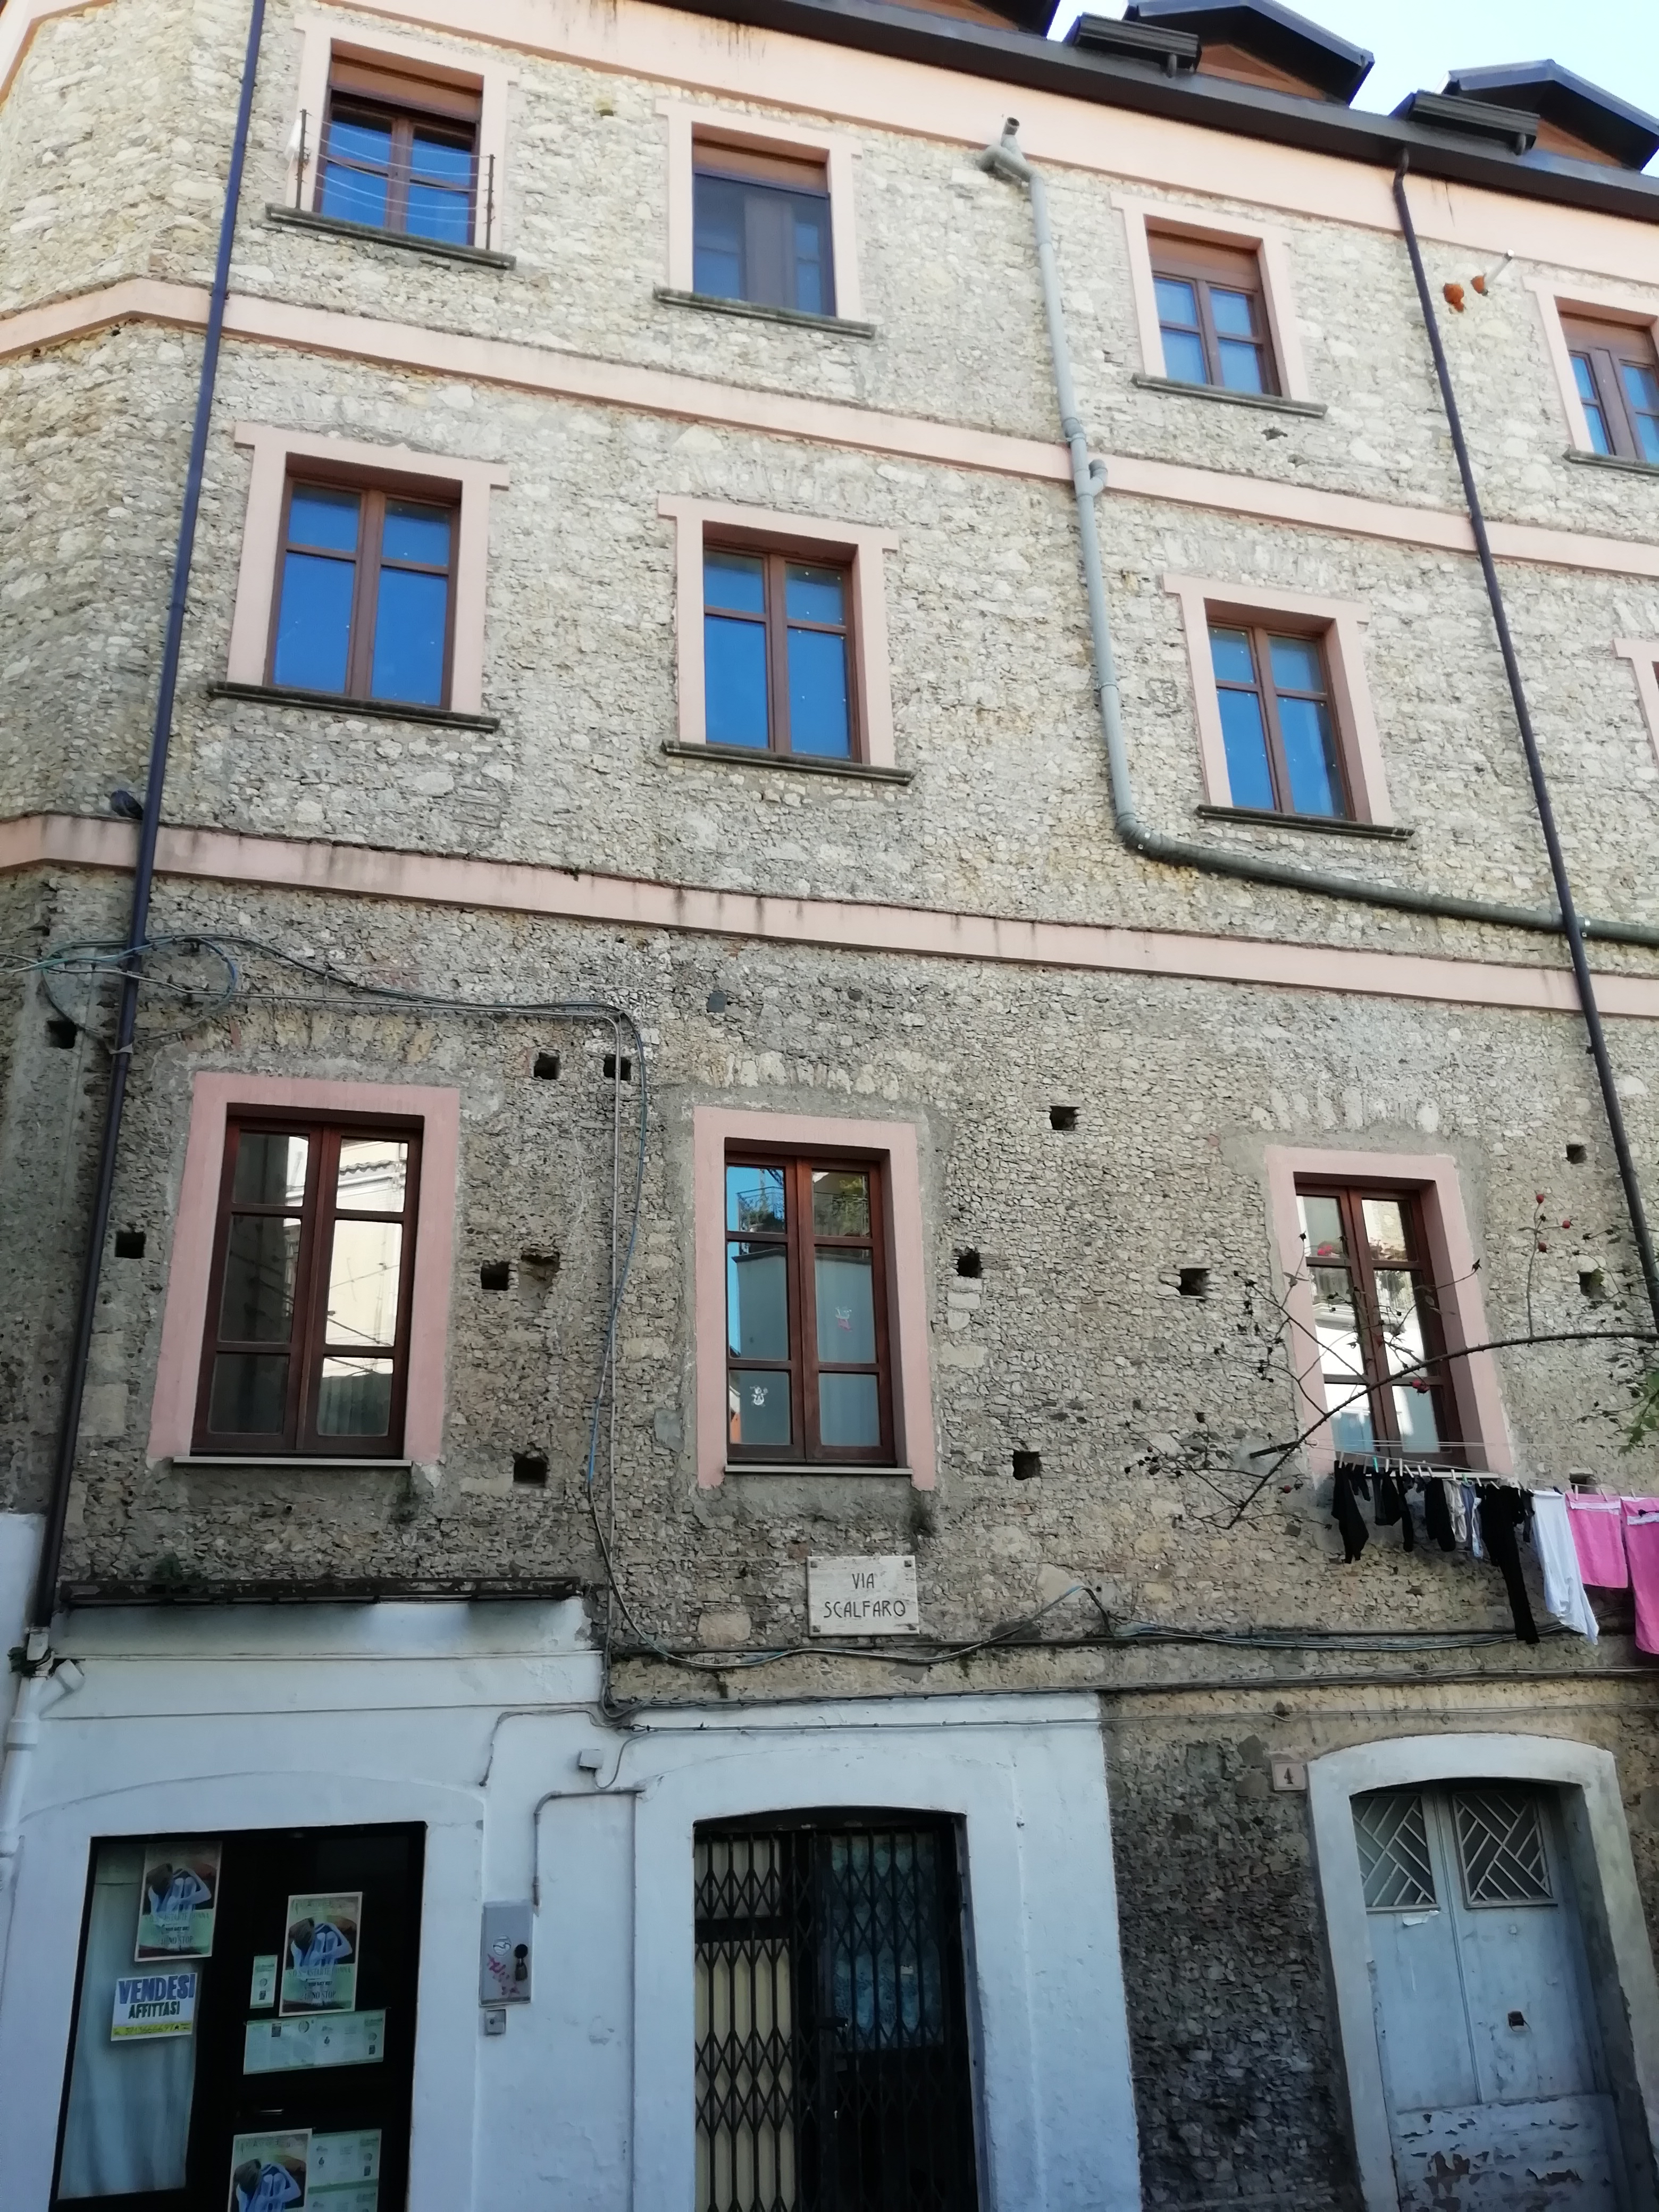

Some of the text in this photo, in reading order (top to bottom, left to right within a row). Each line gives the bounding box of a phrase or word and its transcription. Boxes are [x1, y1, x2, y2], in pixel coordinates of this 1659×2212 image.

[852, 1572, 875, 1589] VIA
[823, 1600, 906, 1618] SCALFARO
[1284, 1766, 1294, 1784] 4
[119, 1974, 196, 2004] VENDESI
[128, 2001, 180, 2019] AFFITTASI
